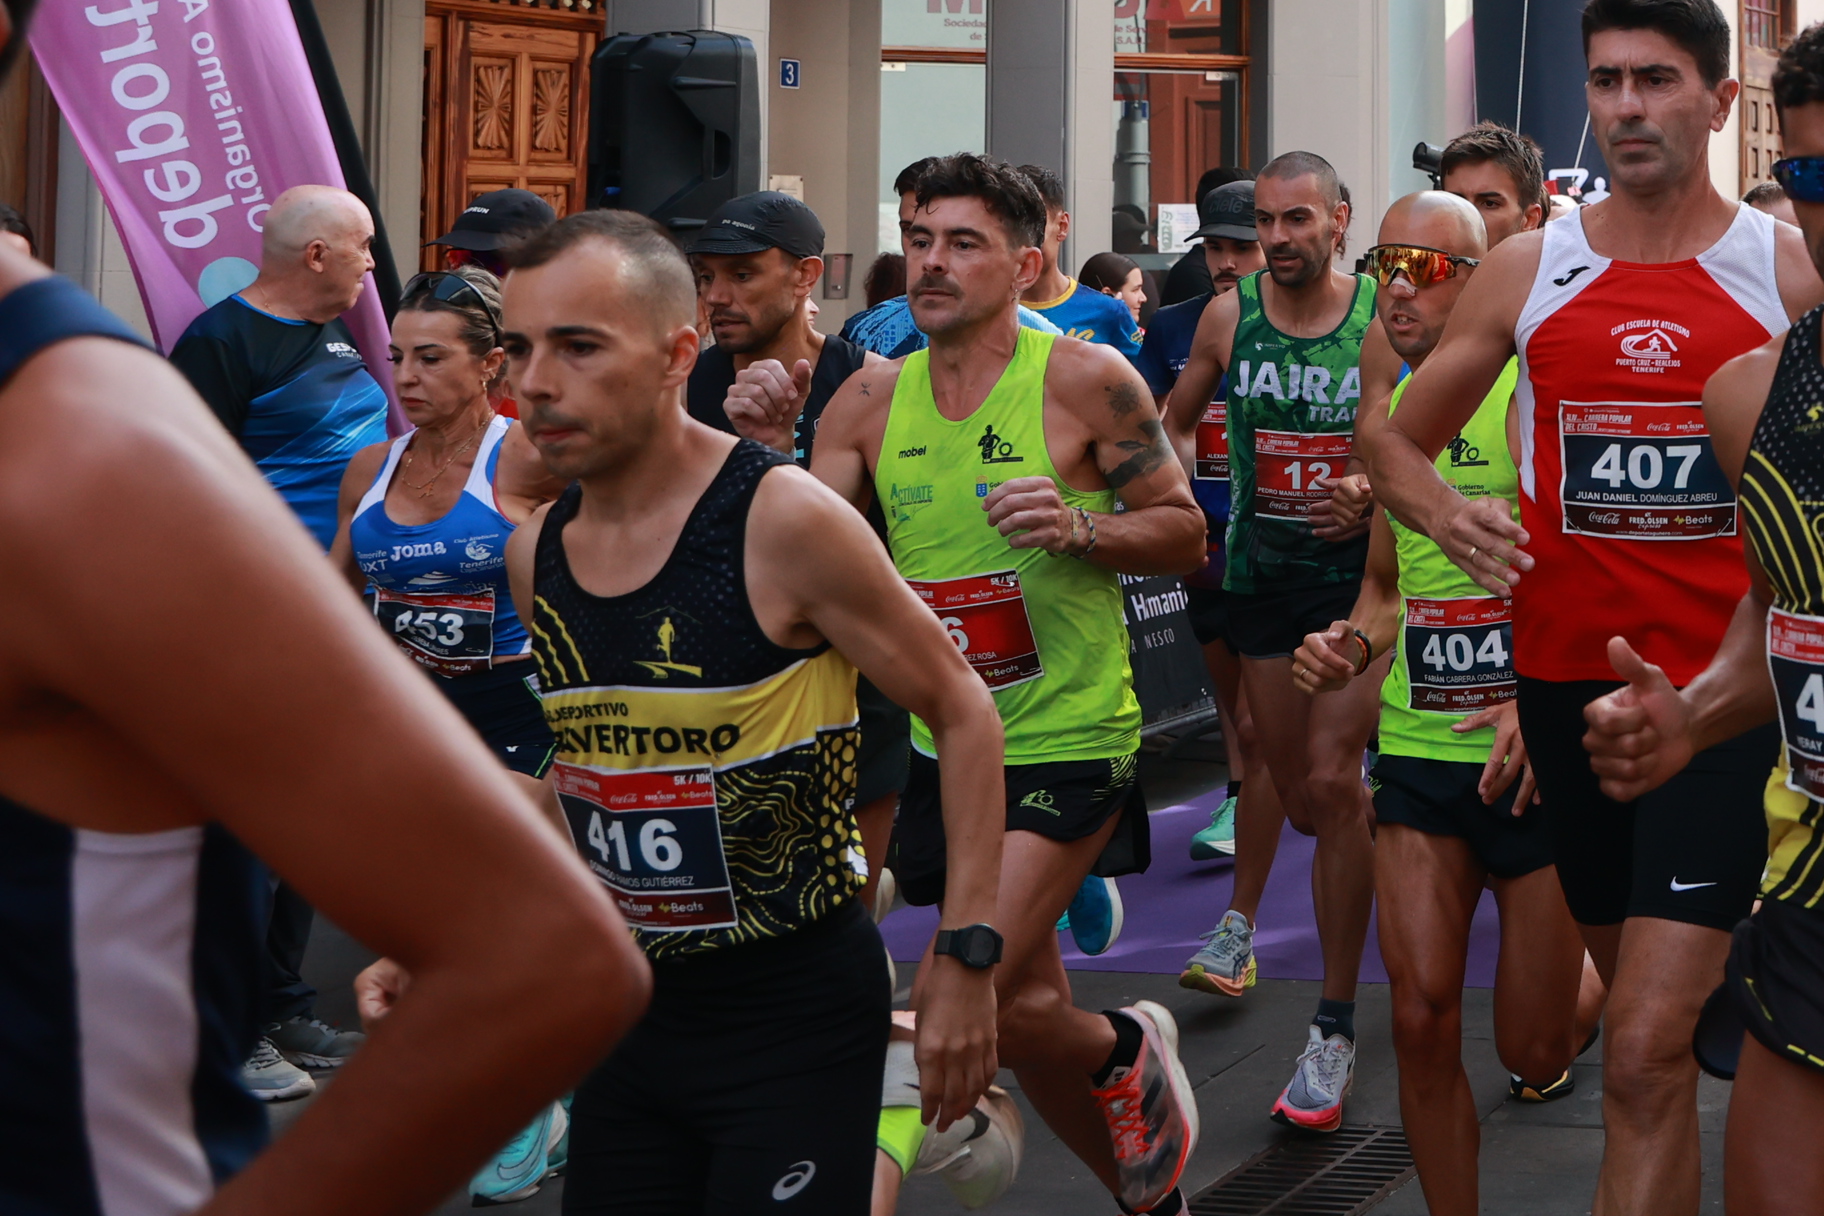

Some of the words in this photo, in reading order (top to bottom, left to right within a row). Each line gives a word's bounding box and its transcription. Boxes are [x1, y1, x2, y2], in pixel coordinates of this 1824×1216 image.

[785, 63, 794, 85] 3
[1610, 323, 1626, 336] CLUB
[1626, 319, 1651, 330] ESCUELA
[1660, 320, 1691, 338] ATLETISMO
[1615, 358, 1636, 366] PUERTO
[1631, 366, 1665, 374] TENERIFE
[1590, 443, 1702, 489] 407
[1284, 461, 1332, 490] 12
[1257, 487, 1278, 495] PEDRO
[1279, 489, 1305, 498] MANUEL
[1575, 490, 1601, 501] JUAN
[1602, 492, 1638, 503] DANIEL
[1639, 492, 1689, 503] DOMÍNGUEZ
[1689, 492, 1718, 502] ABREU
[1685, 515, 1713, 525] Beats
[395, 610, 464, 646] 453
[978, 651, 997, 660] ROSA
[1422, 629, 1509, 672] 404
[994, 665, 1020, 677] Beats
[1424, 674, 1445, 683] FABIÁN
[1446, 674, 1476, 683] CABRERA
[1477, 671, 1514, 682] GONZÁLEZ
[1498, 688, 1517, 698] Beat
[673, 774, 686, 786] 5K
[695, 772, 712, 784] 10K
[588, 810, 683, 871] 416
[641, 875, 695, 887] GUTIÉRREZ
[670, 900, 704, 913] Beats
